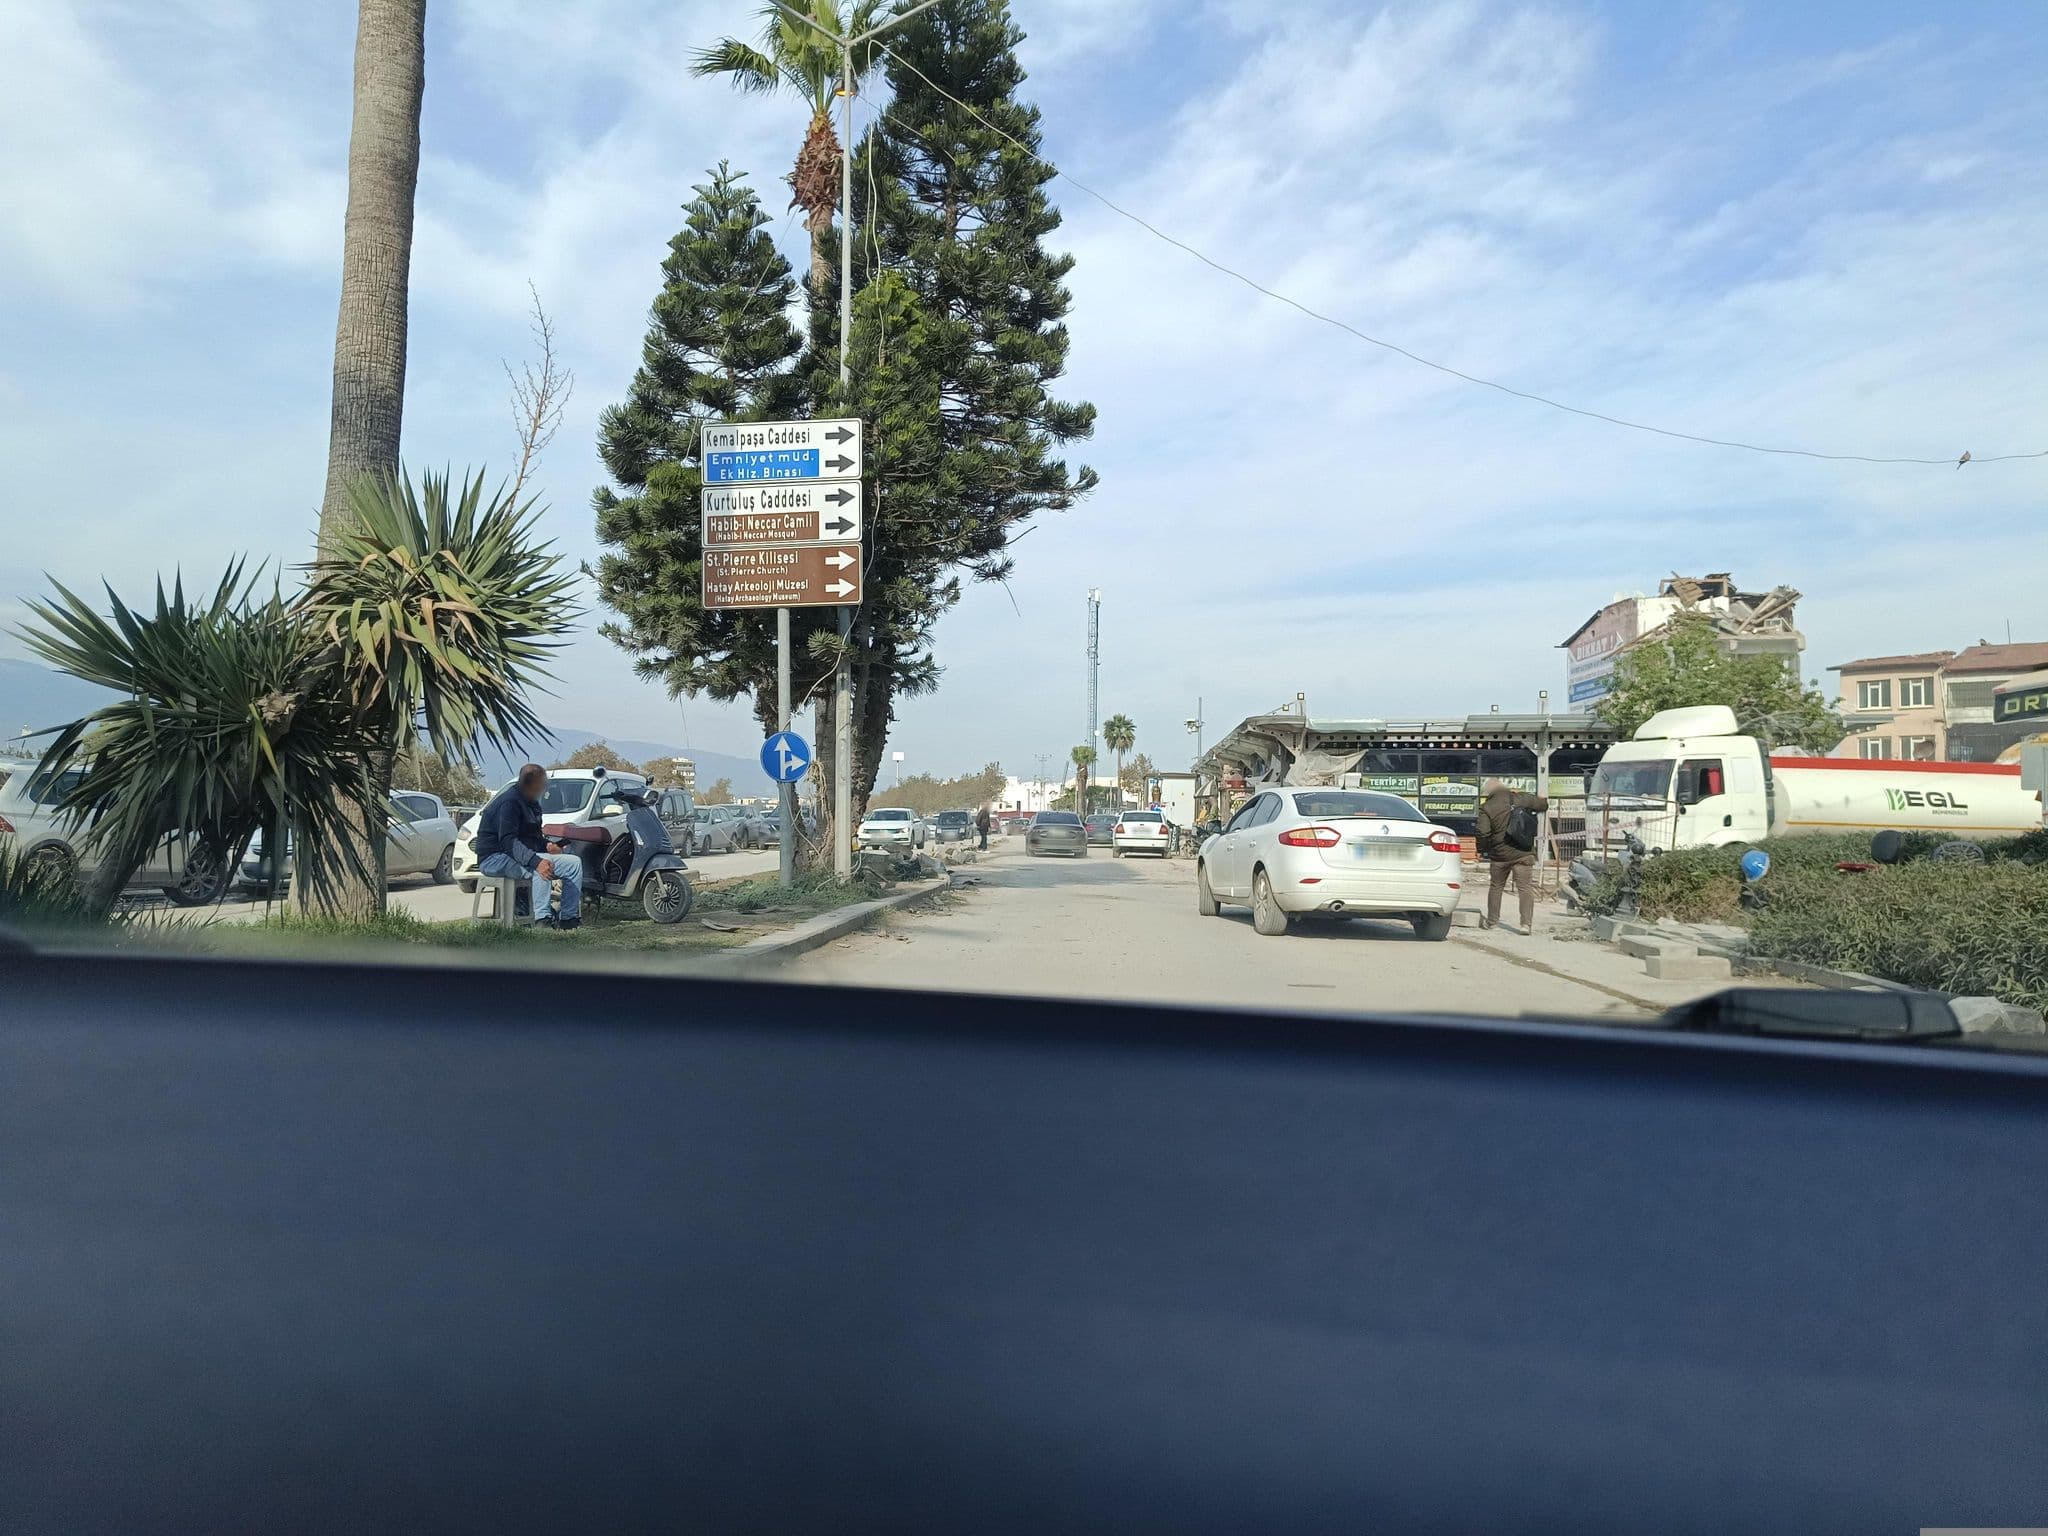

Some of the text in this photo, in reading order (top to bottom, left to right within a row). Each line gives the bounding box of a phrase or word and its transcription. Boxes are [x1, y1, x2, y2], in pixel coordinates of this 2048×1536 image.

[706, 427, 810, 450] Kemalpaşa Caddesi
[720, 469, 734, 480] Ek
[706, 491, 755, 512] Kurtuluş
[747, 515, 781, 530] Neccar
[783, 514, 813, 529] Camii
[743, 531, 767, 540] Neccar
[767, 529, 797, 540] Mosque)
[706, 551, 799, 567] St. Pierre Kilisesi
[717, 566, 789, 578] (St. Pierre Church)
[706, 582, 733, 594] Hatay
[734, 580, 774, 593] Arkeoloji
